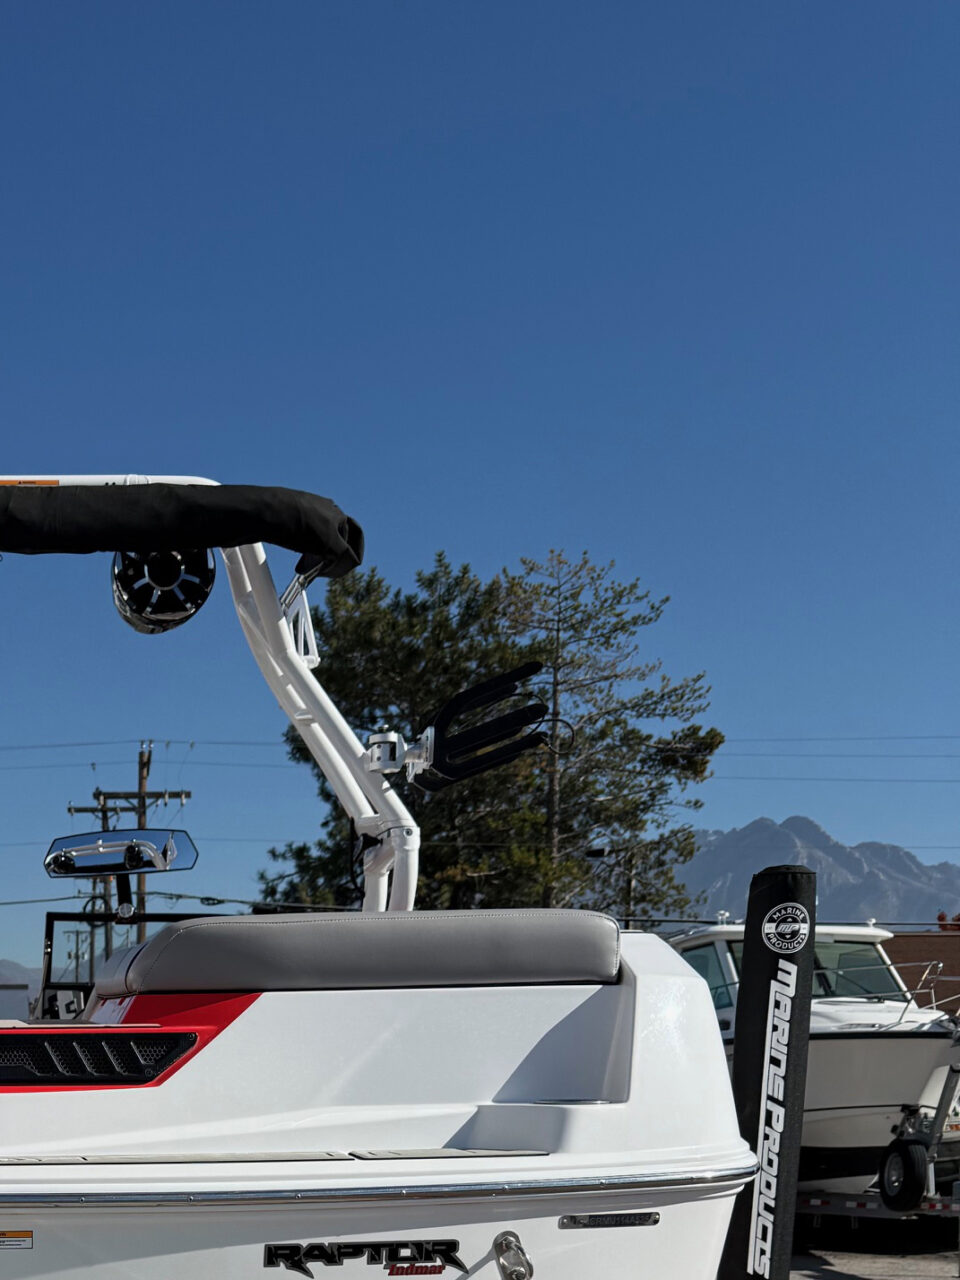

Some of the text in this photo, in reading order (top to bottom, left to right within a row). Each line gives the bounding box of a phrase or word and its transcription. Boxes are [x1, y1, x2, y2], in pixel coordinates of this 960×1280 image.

[772, 907, 805, 920] MARINE
[768, 933, 806, 949] PRODUCTS
[753, 958, 798, 1280] MARINE PRODUCTS
[264, 1239, 469, 1279] RAPTOR
[388, 1263, 446, 1276] Indmar
